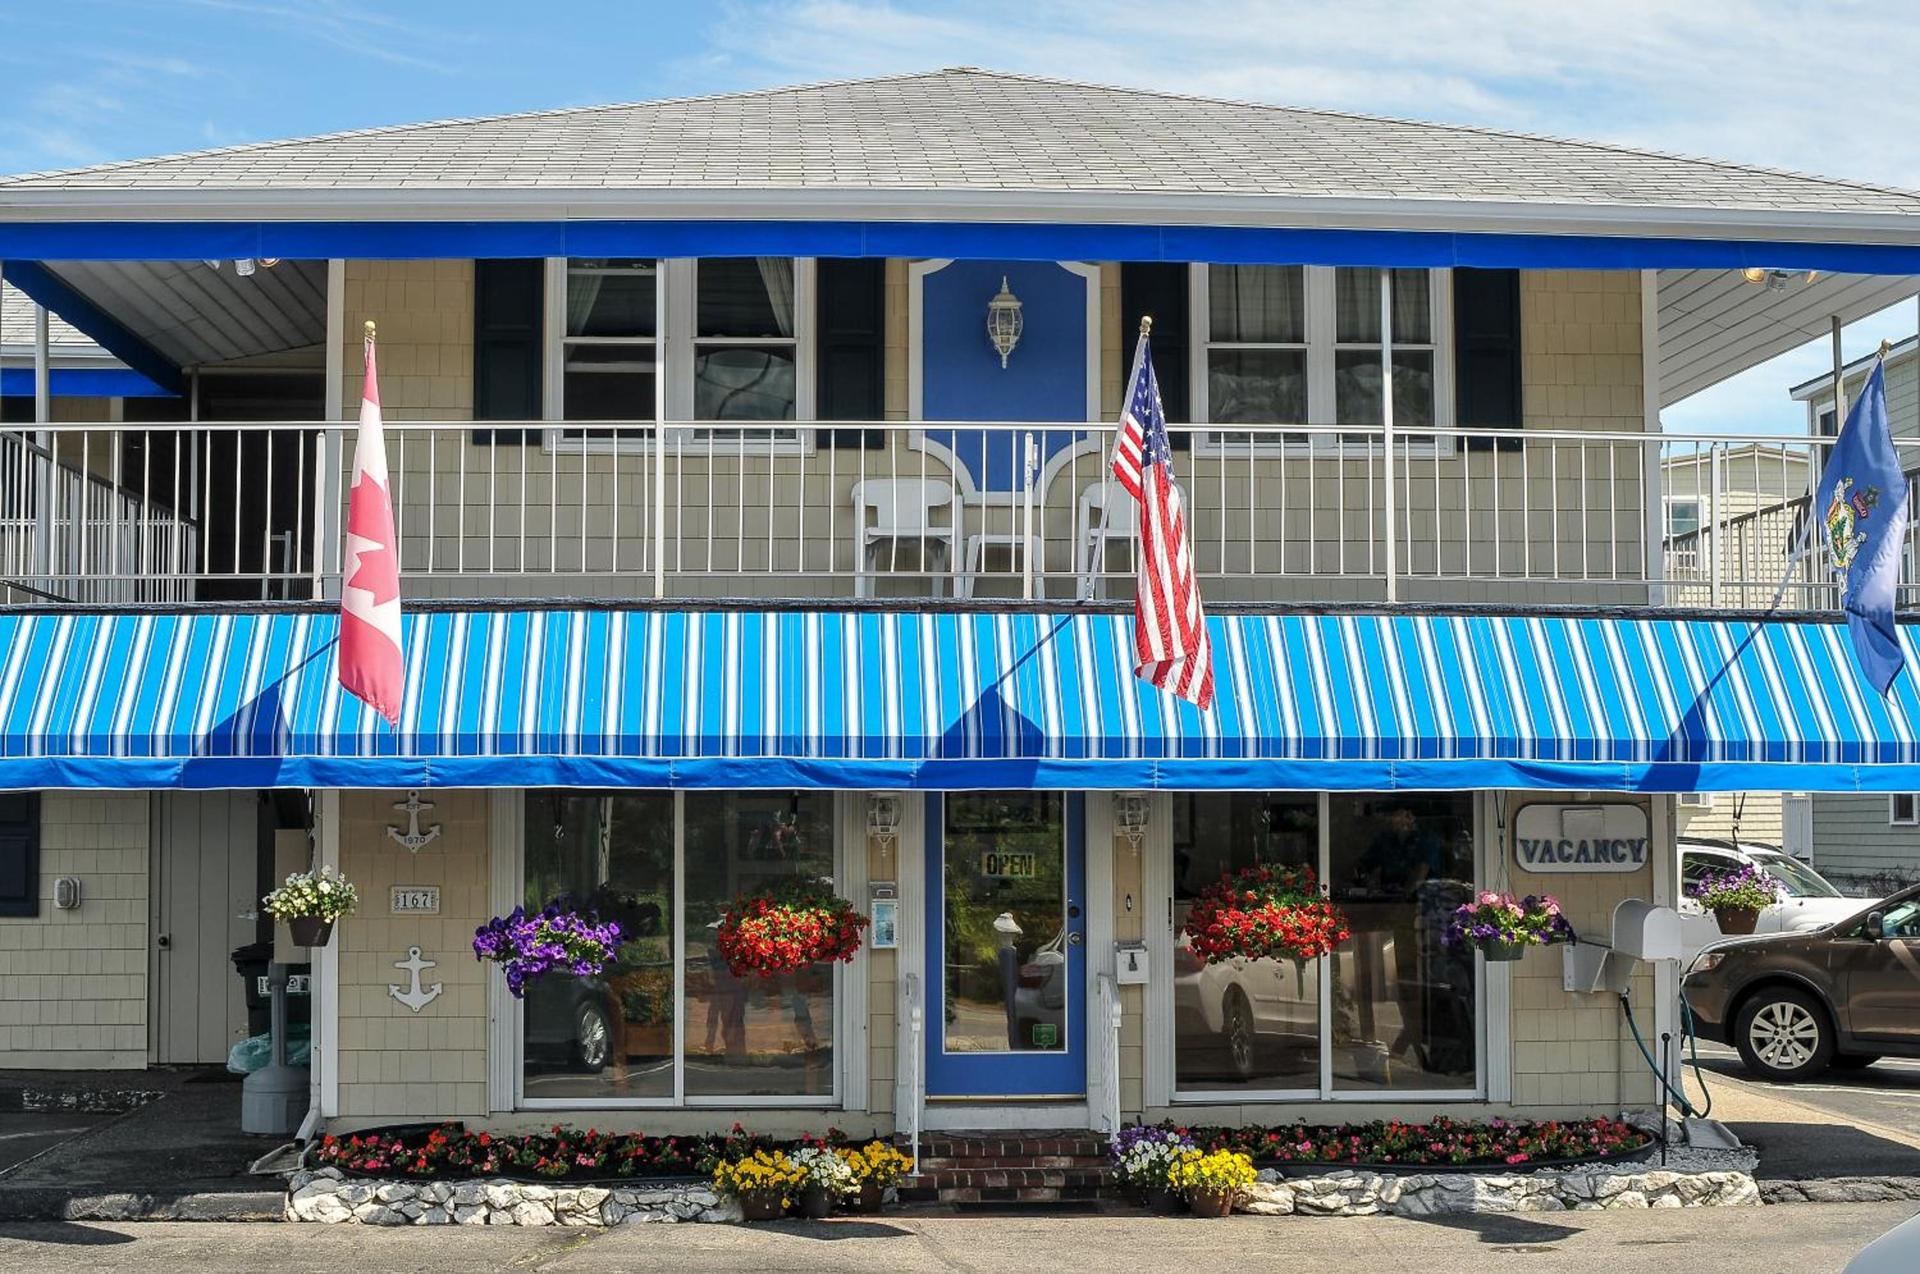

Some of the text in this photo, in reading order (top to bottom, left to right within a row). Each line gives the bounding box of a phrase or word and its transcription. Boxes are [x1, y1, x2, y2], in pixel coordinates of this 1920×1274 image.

[404, 836, 426, 845] 1970
[1519, 838, 1647, 864] VACANCY
[986, 854, 1033, 876] OPEN
[402, 893, 429, 907] 167
